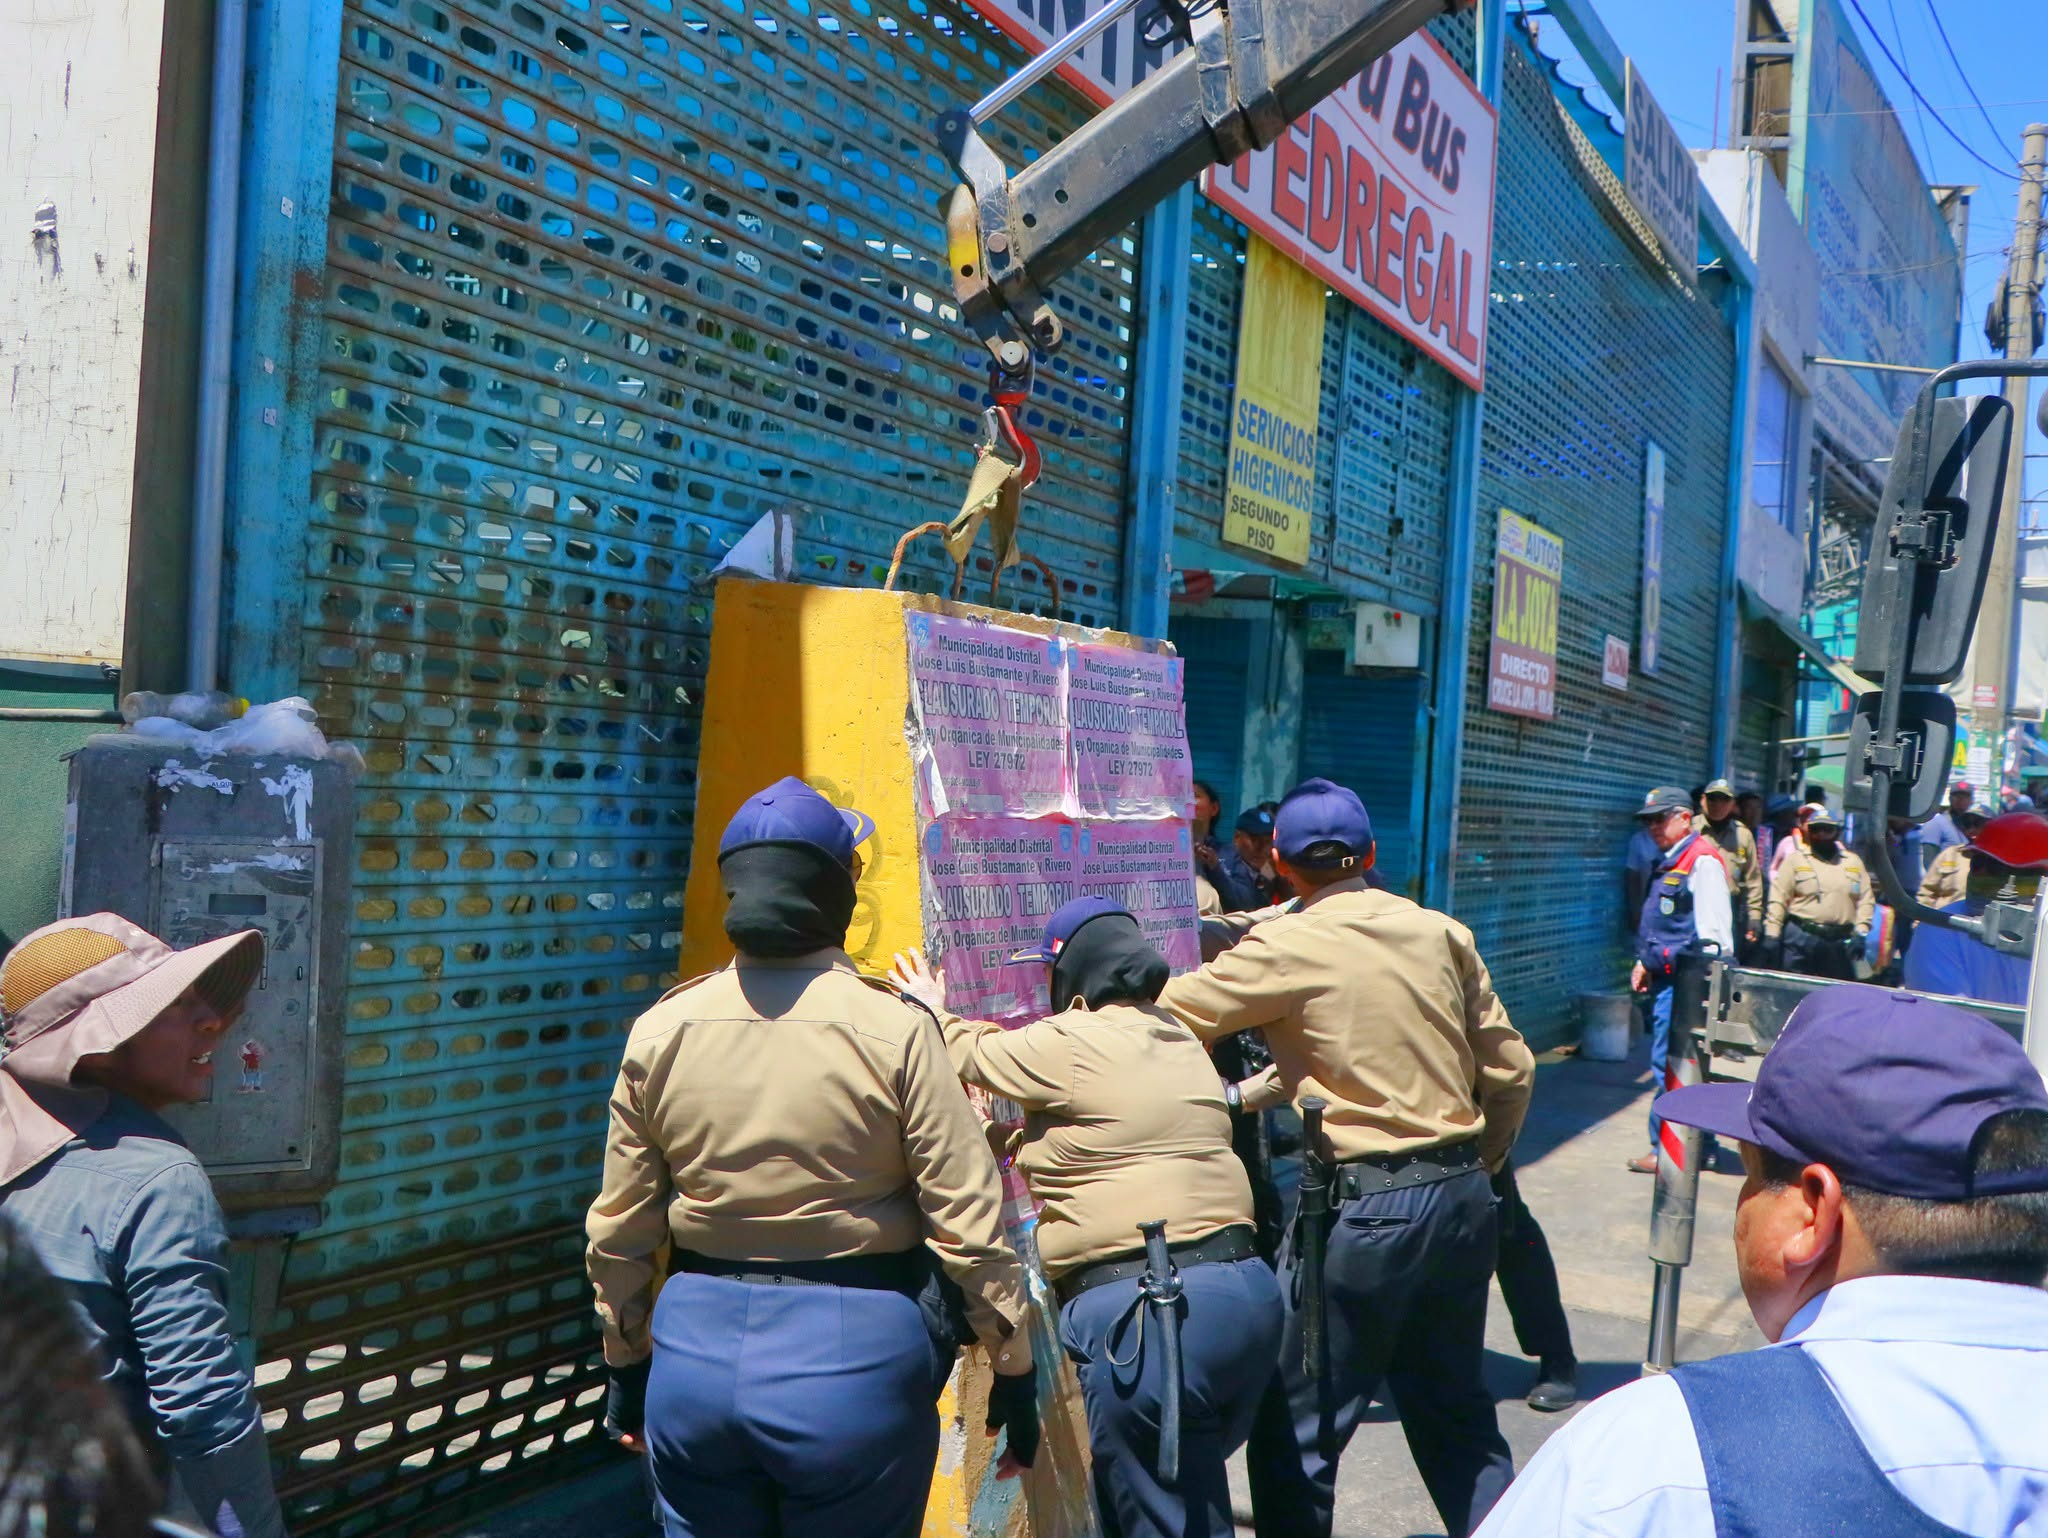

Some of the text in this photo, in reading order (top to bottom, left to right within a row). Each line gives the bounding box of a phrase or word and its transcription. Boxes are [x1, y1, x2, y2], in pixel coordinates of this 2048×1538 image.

[1392, 53, 1467, 196] Bus
[1631, 79, 1696, 232] SALIDA
[1631, 156, 1644, 201] DE
[1237, 398, 1315, 470] SERVICIOS
[1232, 447, 1313, 513] HIGIENICOS
[1231, 494, 1290, 532] SEGUNDO
[1247, 525, 1275, 551] PISO
[1525, 529, 1560, 573] AUTOS
[1496, 561, 1557, 657] LA JOYA
[938, 634, 1041, 665] Municipalidad Distrital
[917, 653, 1059, 687] José Luis Bustamante y Rivero
[1084, 657, 1163, 683] Municipalidad Distrital
[1500, 652, 1549, 686] DIRECTO
[1090, 678, 1106, 693] Luis
[1108, 681, 1149, 698] Bustamante
[1151, 691, 1156, 702] y
[1157, 687, 1177, 702] Rivero
[1004, 689, 1066, 728] TEMPORAL
[1073, 697, 1184, 739] LAUSURADO TEMPORAL
[926, 724, 1065, 752] ey Orgánica de Municipalidades
[1075, 740, 1085, 756] ey
[1121, 741, 1130, 755] de
[1131, 741, 1184, 759] Municipalidades
[968, 750, 1026, 771] LEY 27972
[1108, 759, 1153, 777] LEY 27972
[951, 836, 1053, 857] Municipalidad Distrital
[1097, 841, 1175, 858] Municipalidad Distrital
[931, 858, 1072, 876] José Luis Bustamante y Rivero
[1103, 861, 1119, 874] Luis
[1120, 860, 1161, 874] Bustamante
[1162, 863, 1167, 874] y
[1168, 858, 1189, 870] Rivero
[931, 884, 1013, 922] LAUSURADO
[1147, 879, 1193, 911] TEMPORAL
[941, 932, 951, 953] ey
[953, 928, 996, 951] Orgánica
[999, 926, 1009, 940] de
[1143, 917, 1194, 933] Municipalidades
[1146, 936, 1166, 952] 972
[981, 950, 1004, 969] LEY
